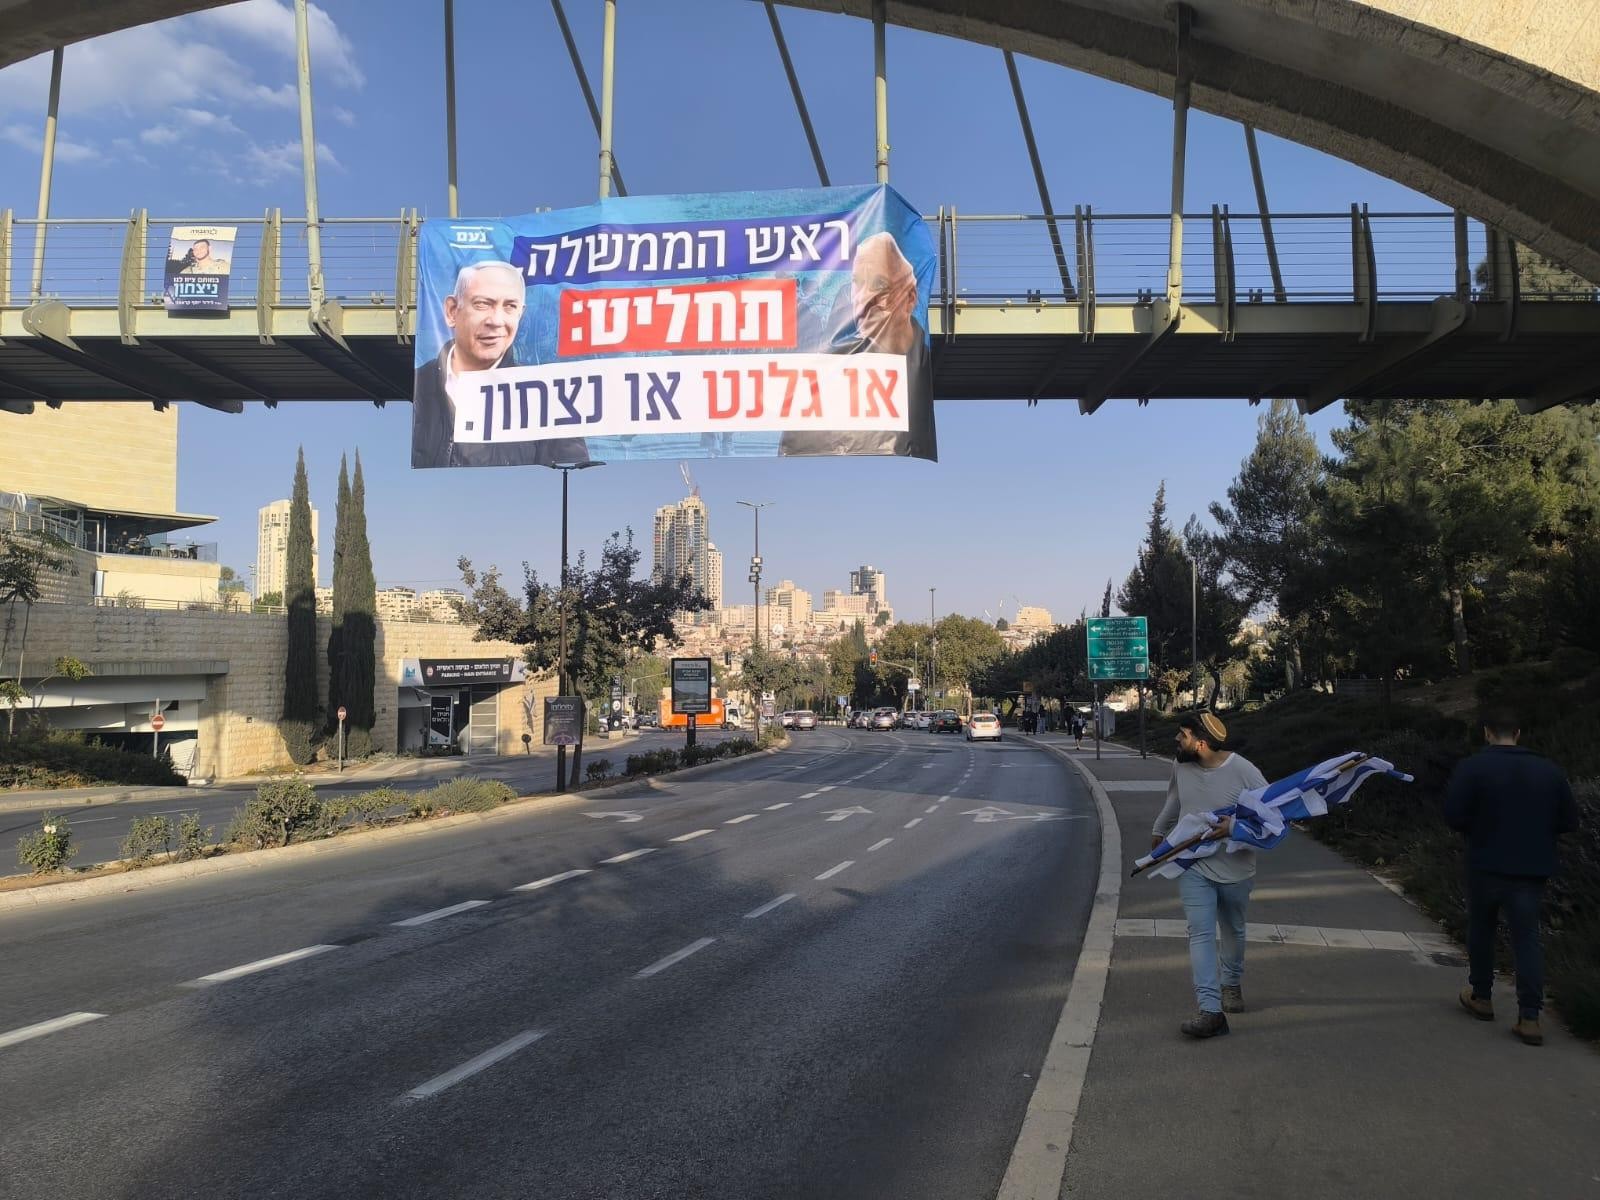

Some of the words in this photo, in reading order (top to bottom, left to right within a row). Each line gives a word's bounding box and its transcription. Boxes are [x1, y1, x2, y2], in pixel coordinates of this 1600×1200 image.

[745, 219, 850, 265] ראש
[174, 283, 218, 298] ניצחון
[571, 288, 783, 346] תחליט:
[464, 373, 604, 441] נצחון.
[625, 371, 682, 421] או
[703, 361, 824, 420] גלנט
[847, 368, 900, 419] או
